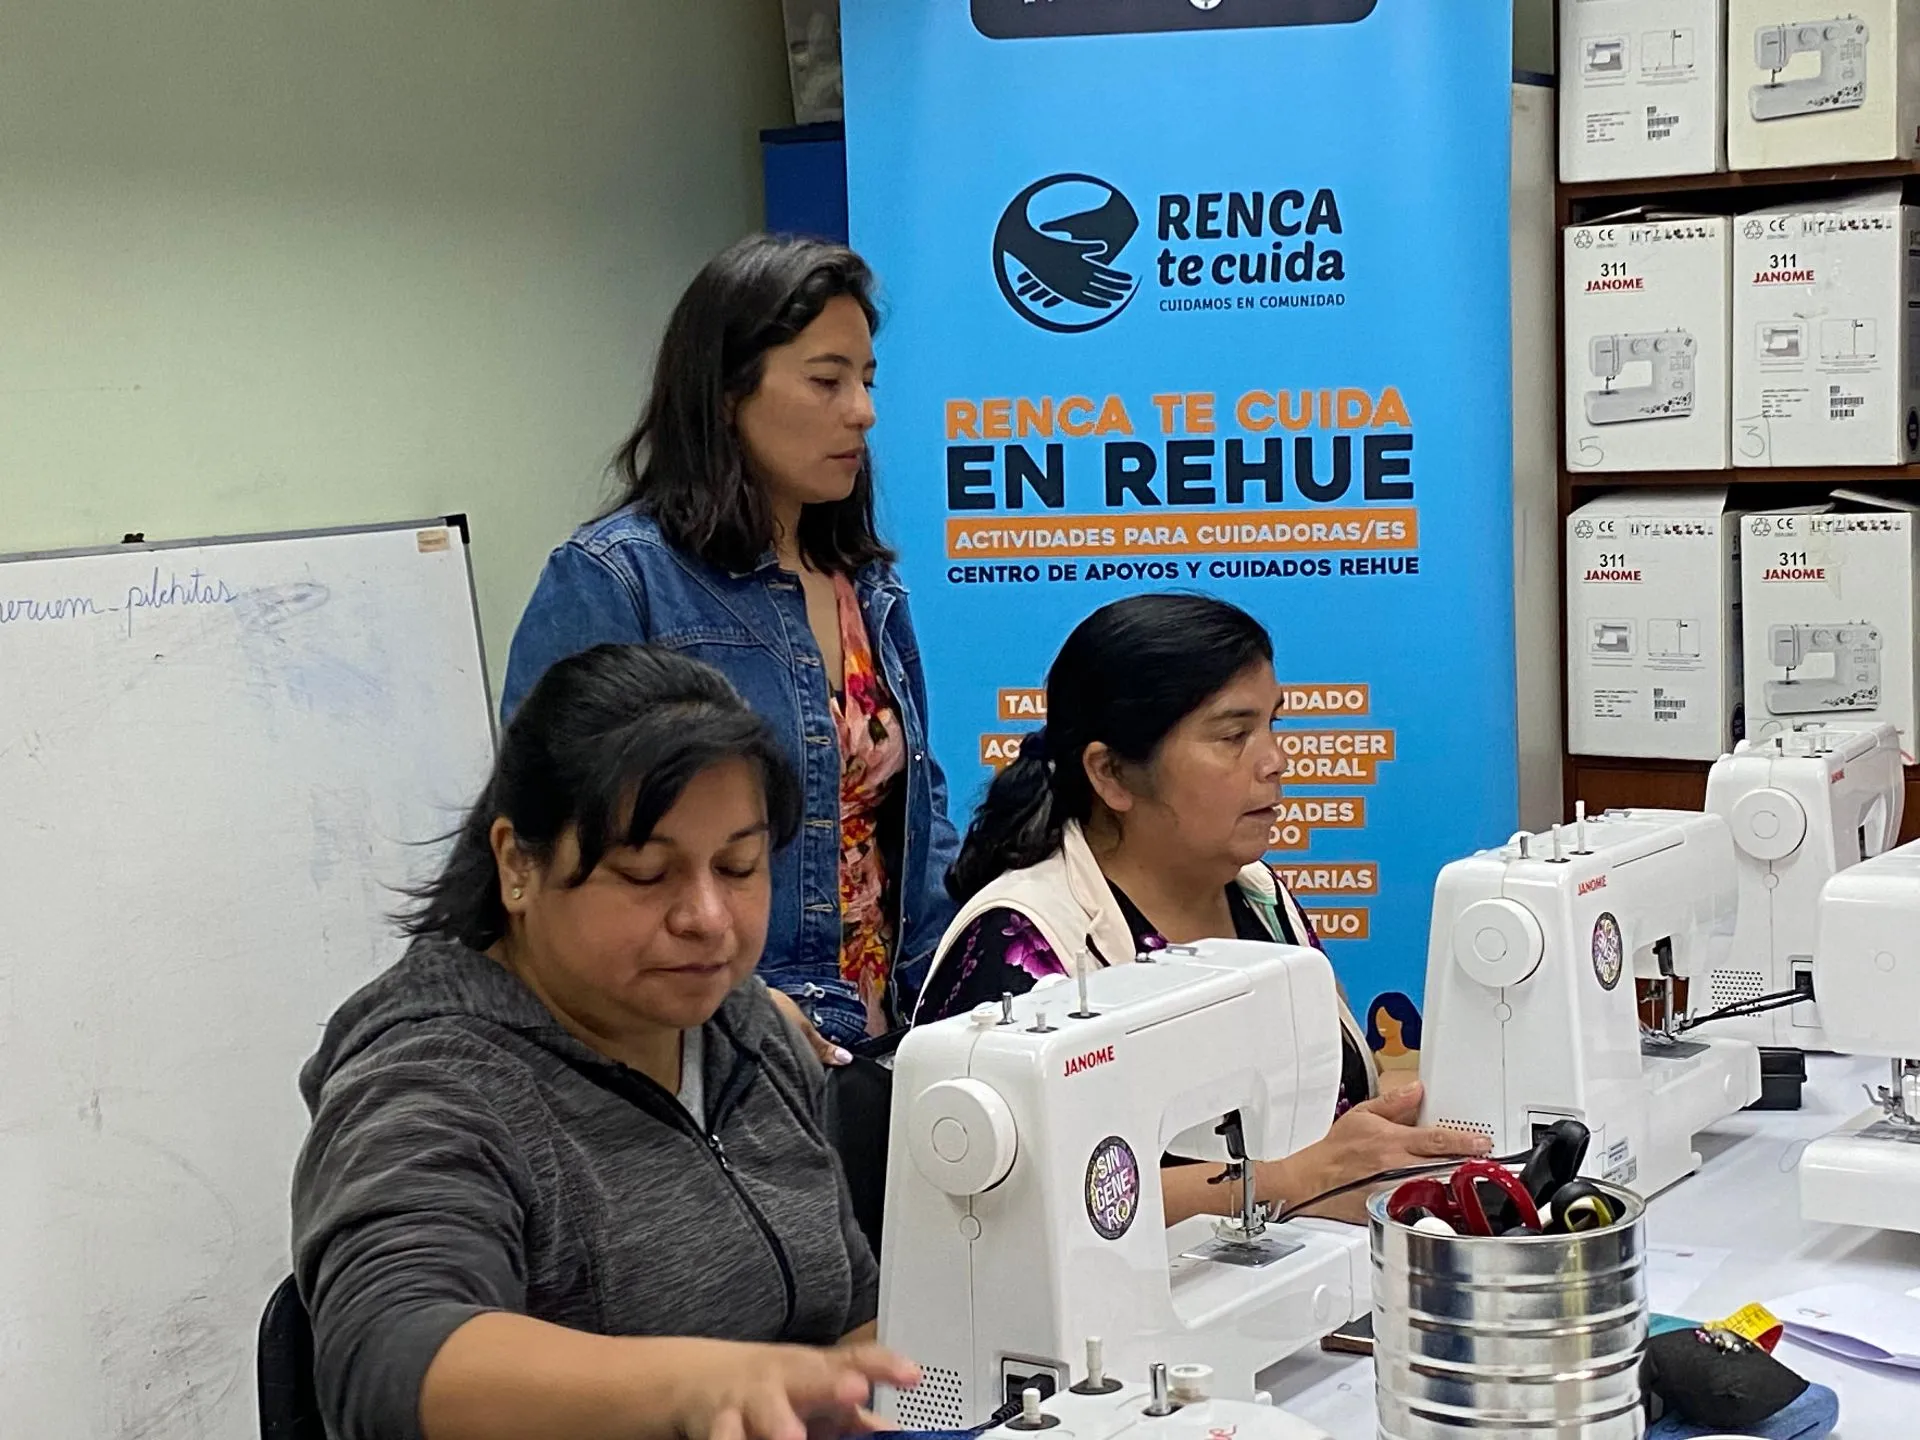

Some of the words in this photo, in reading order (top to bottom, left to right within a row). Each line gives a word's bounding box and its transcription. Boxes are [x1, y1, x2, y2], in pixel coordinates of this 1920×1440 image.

[1158, 188, 1343, 241] RENCA
[1157, 248, 1204, 287] te
[1211, 240, 1345, 285] cuida
[1600, 262, 1627, 277] 311
[1769, 253, 1797, 268] 311
[1585, 278, 1644, 292] JANOME
[1752, 270, 1815, 283] JANOME
[1159, 298, 1232, 312] CUIDAMOS
[1237, 296, 1255, 309] EN
[1259, 294, 1346, 309] COMUNIDAD
[946, 396, 1134, 439] RENCA
[1154, 393, 1216, 434] TE
[1237, 387, 1413, 432] CUIDA
[1571, 435, 1605, 468] 5
[946, 443, 1065, 510] EN
[1105, 434, 1414, 507] REHUE
[954, 528, 1116, 550] ACTIVIDADES
[1124, 526, 1189, 546] PARA
[1197, 521, 1406, 545] CUIDADORAS/ES
[1599, 553, 1625, 568] 311
[1779, 552, 1807, 566] 311
[947, 564, 1040, 584] CENTRO
[1049, 563, 1077, 582] DE
[1085, 561, 1179, 581] APOYOS
[1187, 561, 1201, 579] Y
[1209, 558, 1332, 578] CUIDADOS
[1340, 556, 1420, 576] REHUE
[1583, 570, 1642, 581] JANOME
[1762, 568, 1825, 580] JANOME
[984, 739, 1023, 759] AC
[1064, 1045, 1115, 1077] JANOME
[1096, 1146, 1121, 1179] SIN
